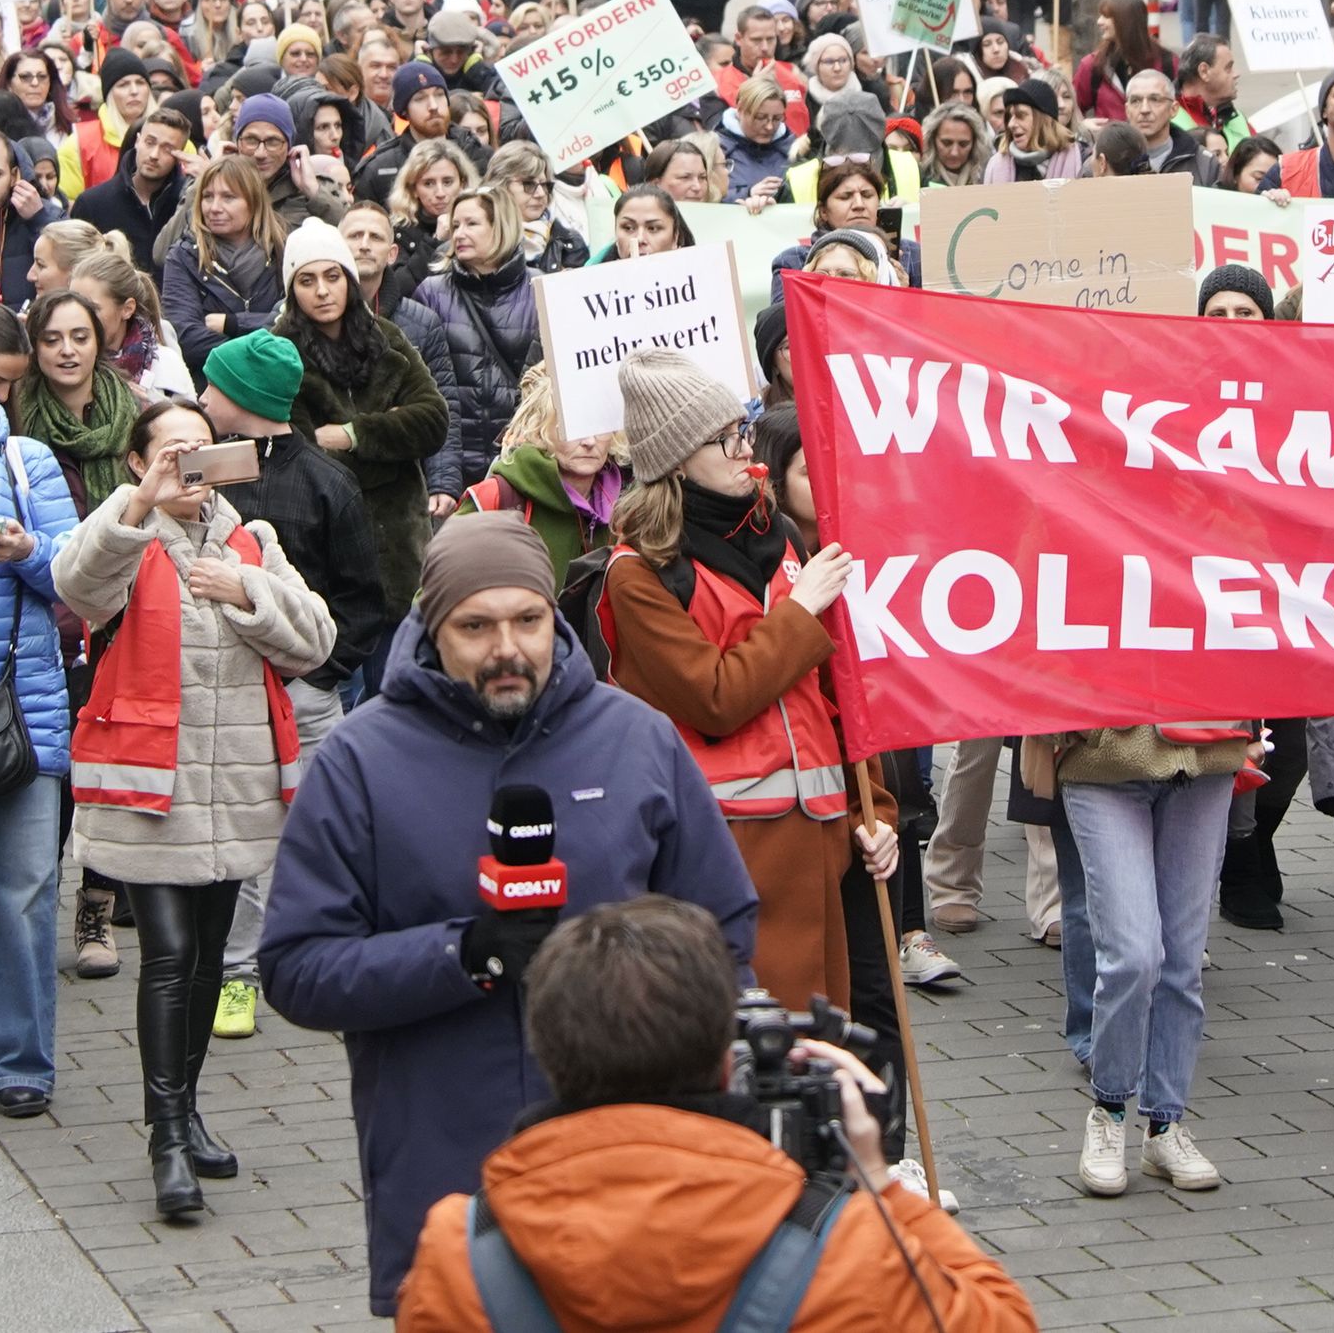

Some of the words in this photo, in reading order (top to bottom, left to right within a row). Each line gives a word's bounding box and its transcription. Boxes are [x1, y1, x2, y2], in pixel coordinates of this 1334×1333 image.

[1249, 5, 1310, 20] Kleinere
[1251, 26, 1322, 45] Gruppen!
[508, 48, 553, 80] WIR
[527, 67, 579, 106] +15
[580, 48, 615, 77] %
[592, 99, 618, 116] mind.
[616, 80, 633, 97] €
[634, 55, 690, 89] 350,-
[665, 68, 703, 102] gpa
[557, 132, 595, 162] vida
[946, 207, 1081, 300] Come
[1098, 248, 1128, 278] in
[583, 289, 635, 321] Wir
[643, 275, 697, 311] sind
[1075, 275, 1138, 312] and
[575, 335, 643, 370] mehr
[651, 315, 720, 349] wert!
[825, 353, 1077, 463] WIR
